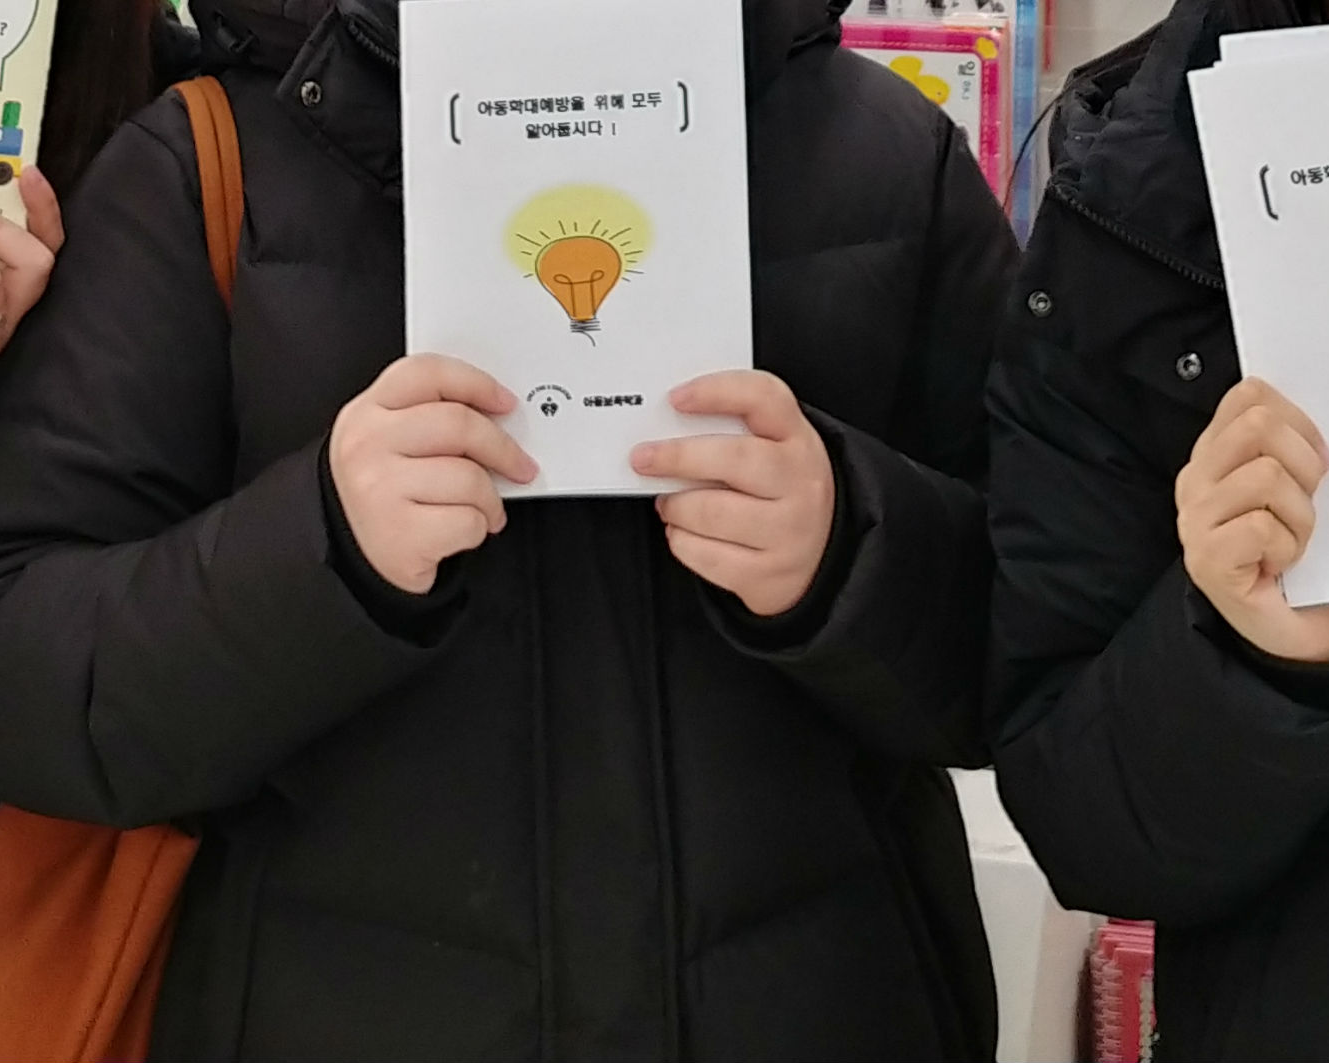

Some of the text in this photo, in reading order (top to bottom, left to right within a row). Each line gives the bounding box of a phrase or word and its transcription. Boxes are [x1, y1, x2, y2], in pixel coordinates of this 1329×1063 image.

[477, 91, 663, 117] 아동학대예방을 위해 모두
[525, 119, 603, 140] 알아둡시다
